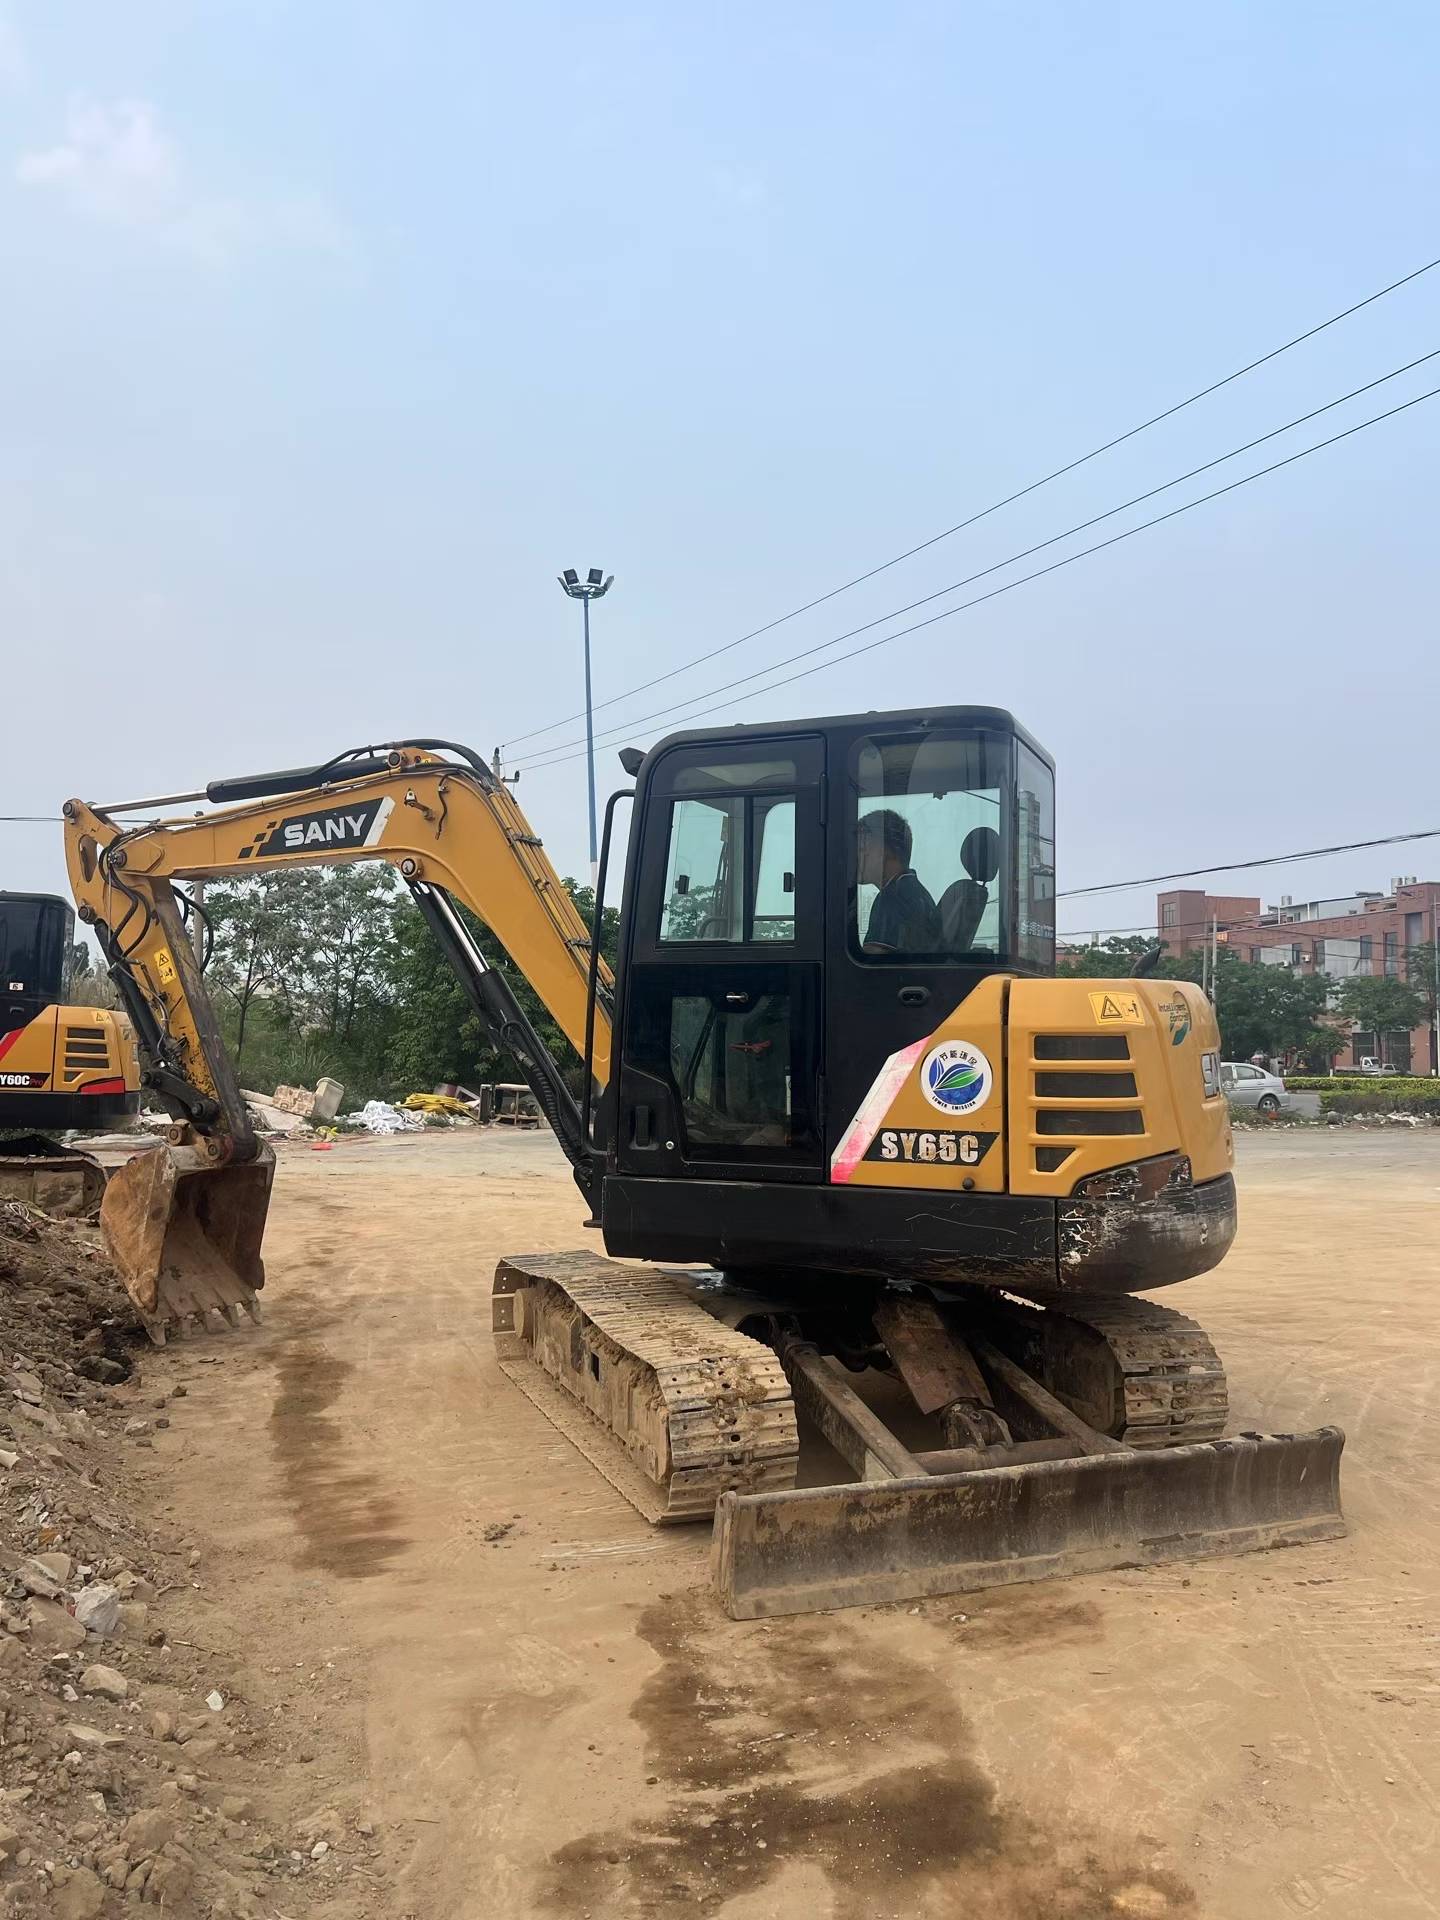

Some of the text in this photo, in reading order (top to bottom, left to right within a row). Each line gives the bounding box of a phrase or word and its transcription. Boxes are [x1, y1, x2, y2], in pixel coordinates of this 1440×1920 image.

[284, 813, 367, 848] SANY
[939, 1050, 978, 1066] 节能环保
[932, 1095, 977, 1111] LOWER EMISSION
[881, 1131, 979, 1163] SY65C
